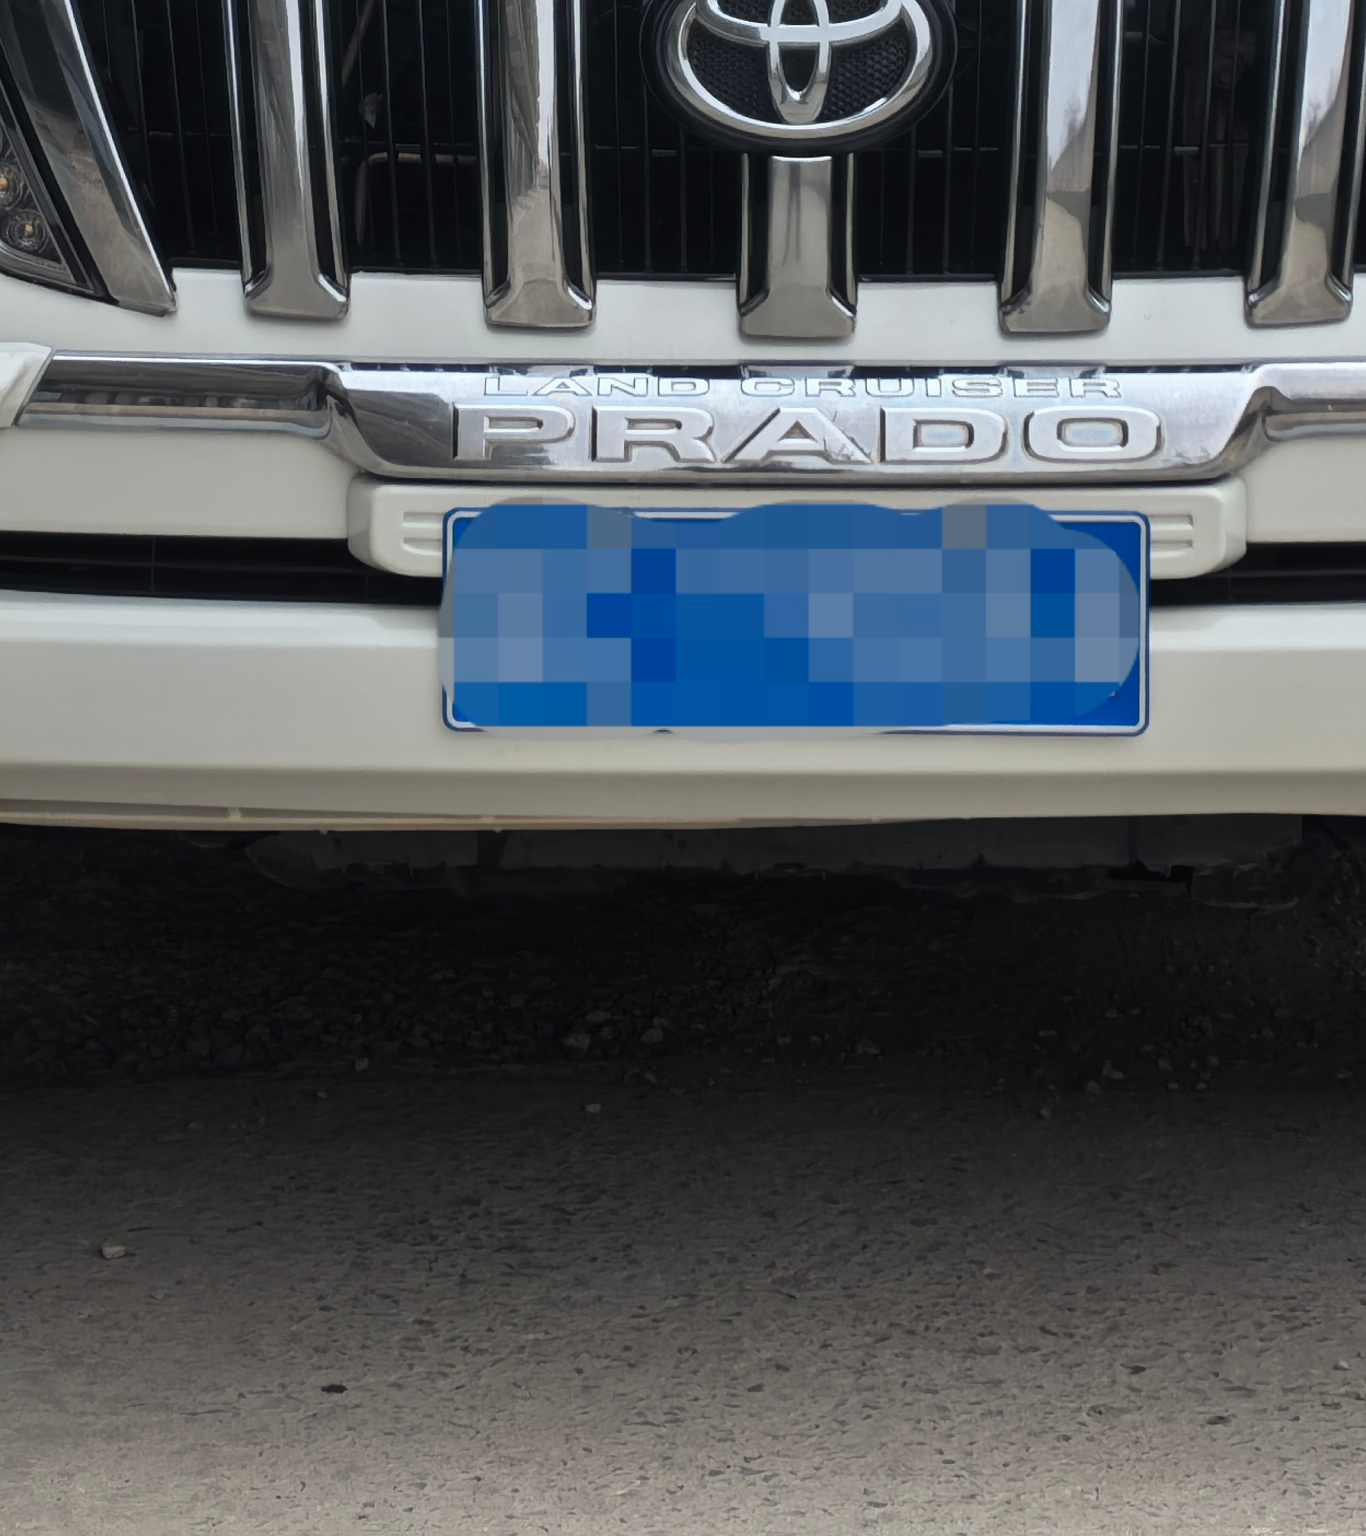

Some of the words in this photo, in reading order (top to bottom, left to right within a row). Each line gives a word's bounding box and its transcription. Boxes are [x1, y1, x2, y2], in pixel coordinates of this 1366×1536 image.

[484, 375, 711, 397] LAND
[740, 377, 1122, 398] CRUISER
[451, 404, 1163, 465] PRADO
